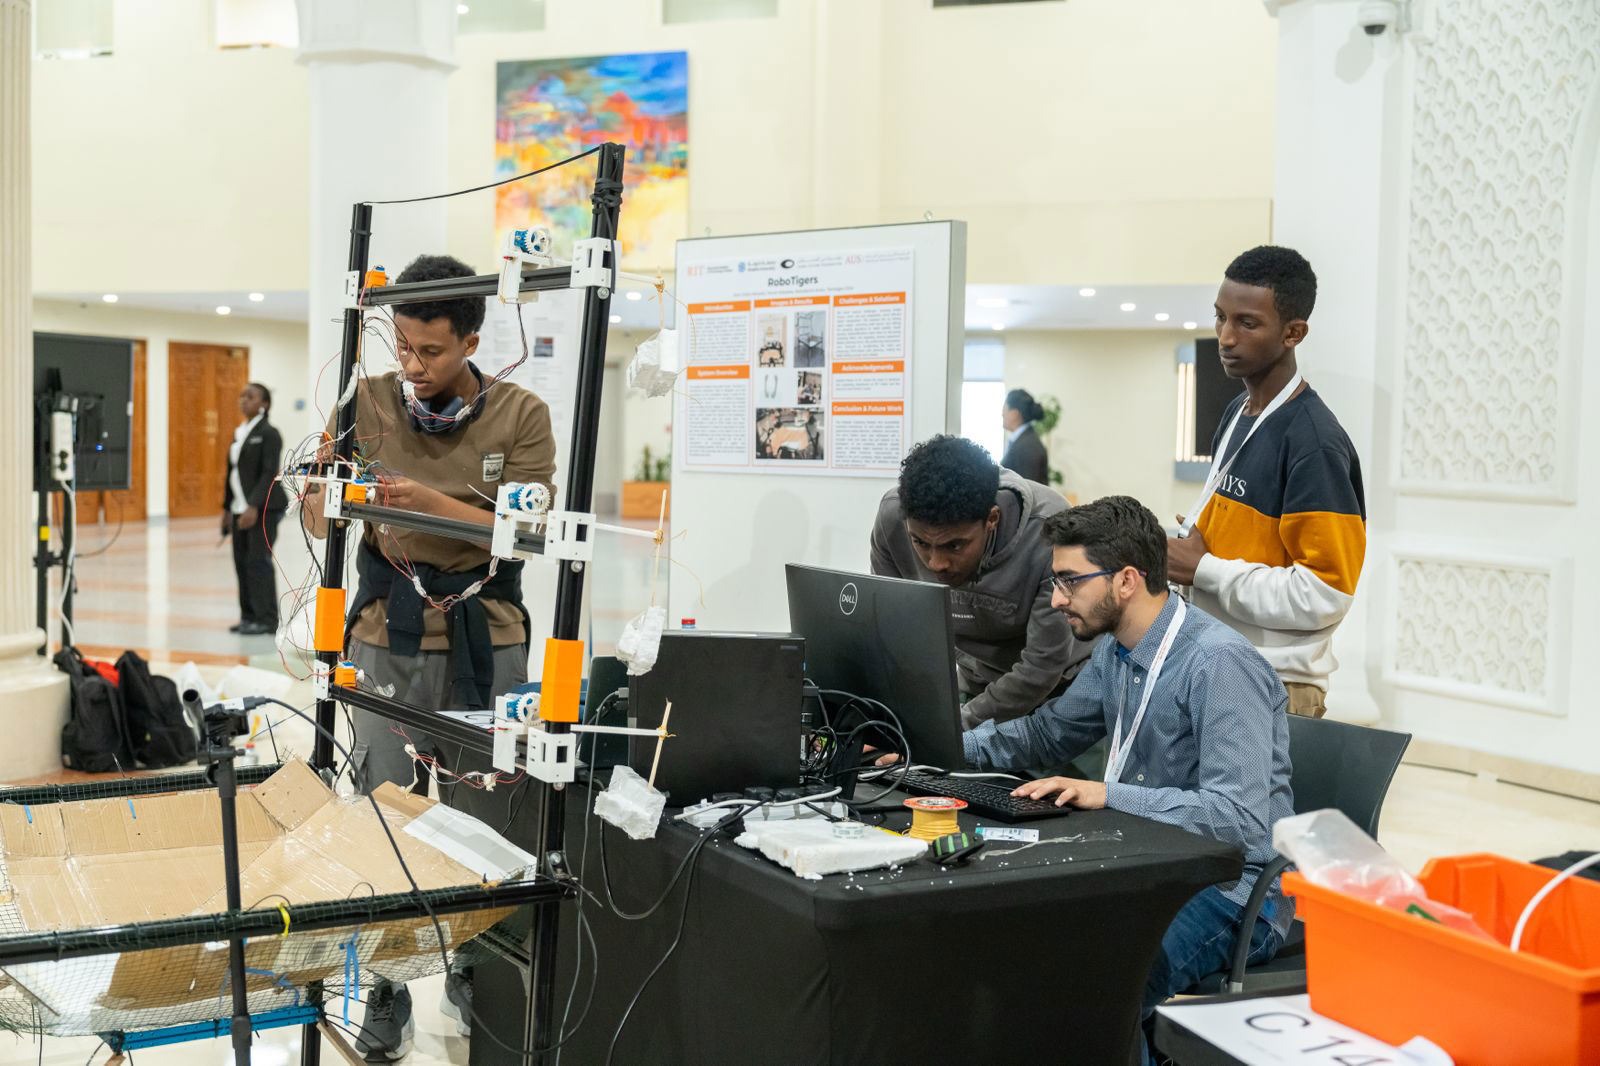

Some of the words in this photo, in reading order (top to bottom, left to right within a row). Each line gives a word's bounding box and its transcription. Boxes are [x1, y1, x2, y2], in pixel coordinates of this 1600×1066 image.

[768, 275, 818, 287] RoboTigers
[839, 297, 868, 305] Challenges
[842, 594, 857, 604] DELL
